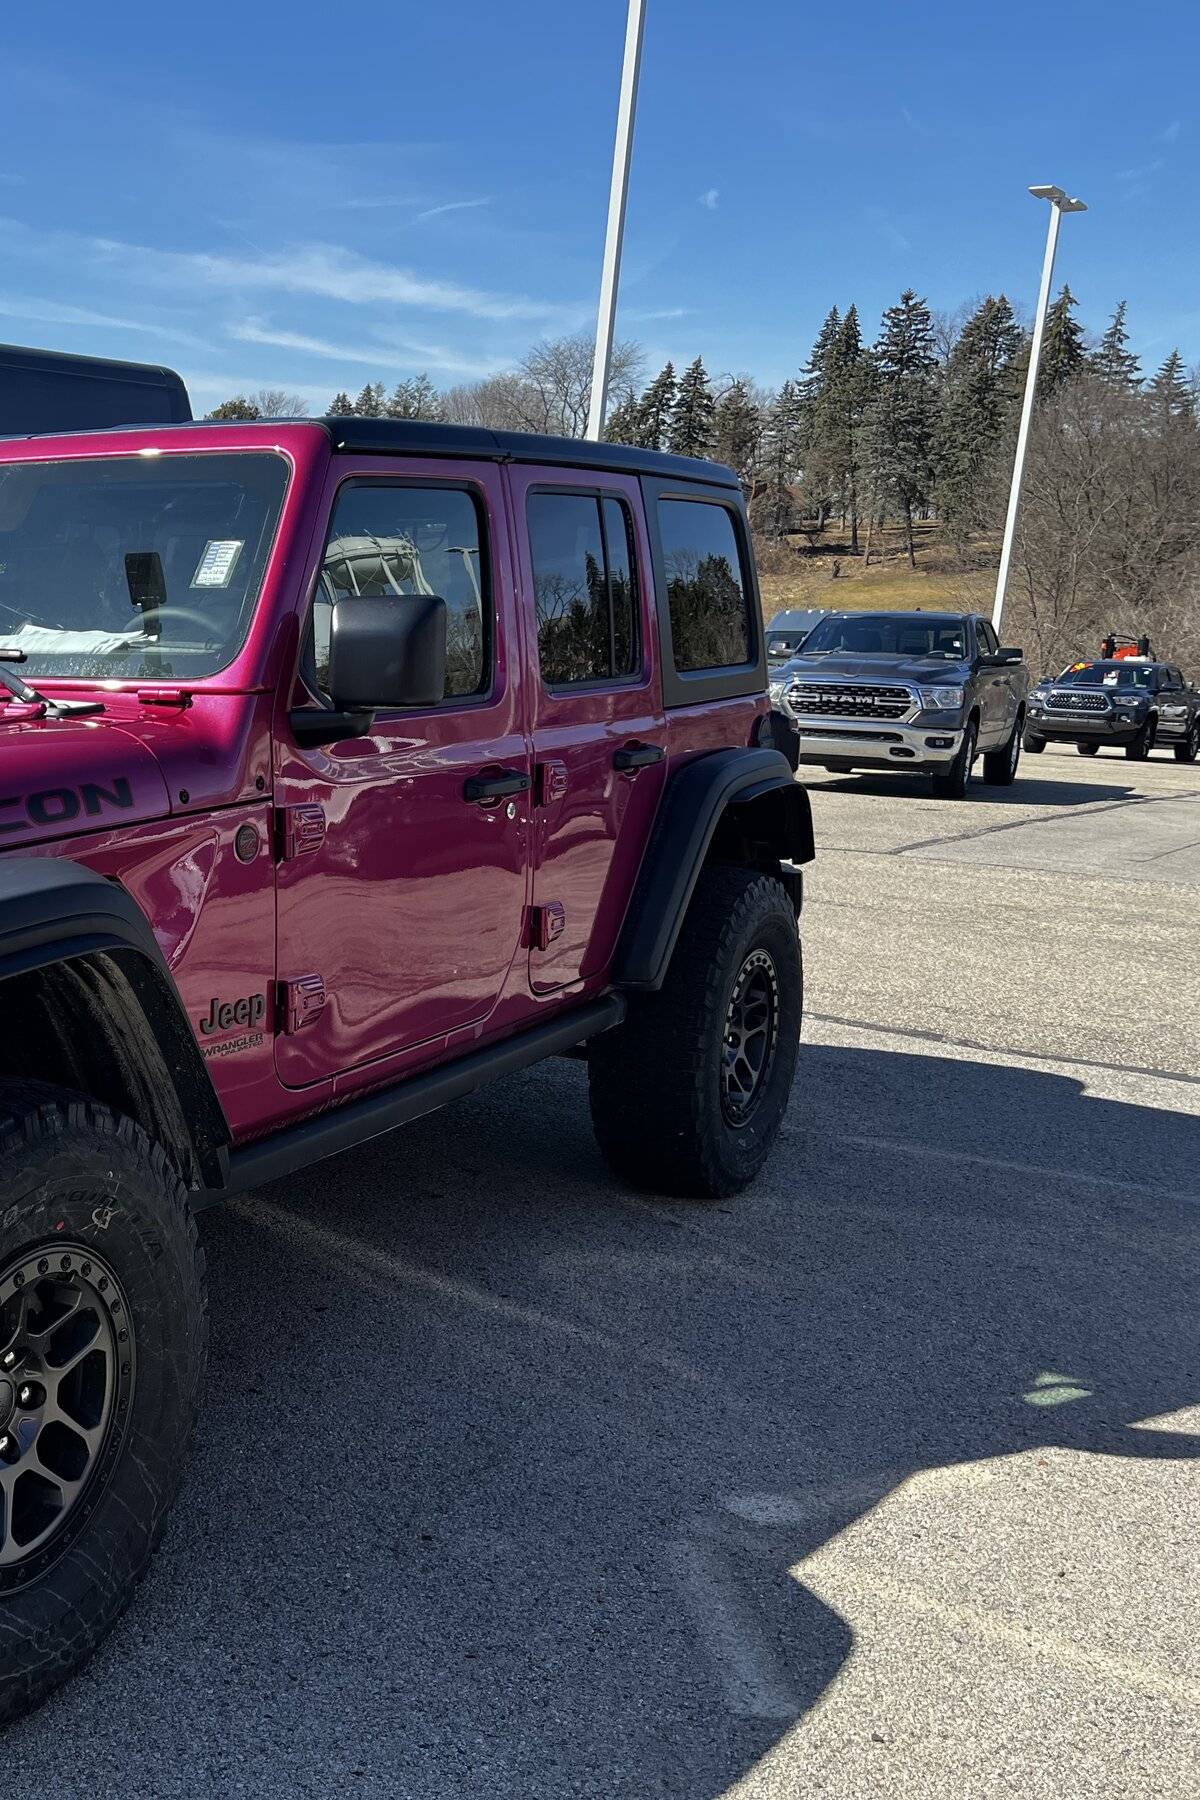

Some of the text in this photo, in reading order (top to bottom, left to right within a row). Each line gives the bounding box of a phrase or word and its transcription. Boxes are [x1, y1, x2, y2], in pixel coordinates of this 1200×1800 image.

[821, 694, 873, 704] RAM
[200, 994, 265, 1034] Jeep
[201, 1033, 263, 1057] WRANGLER
